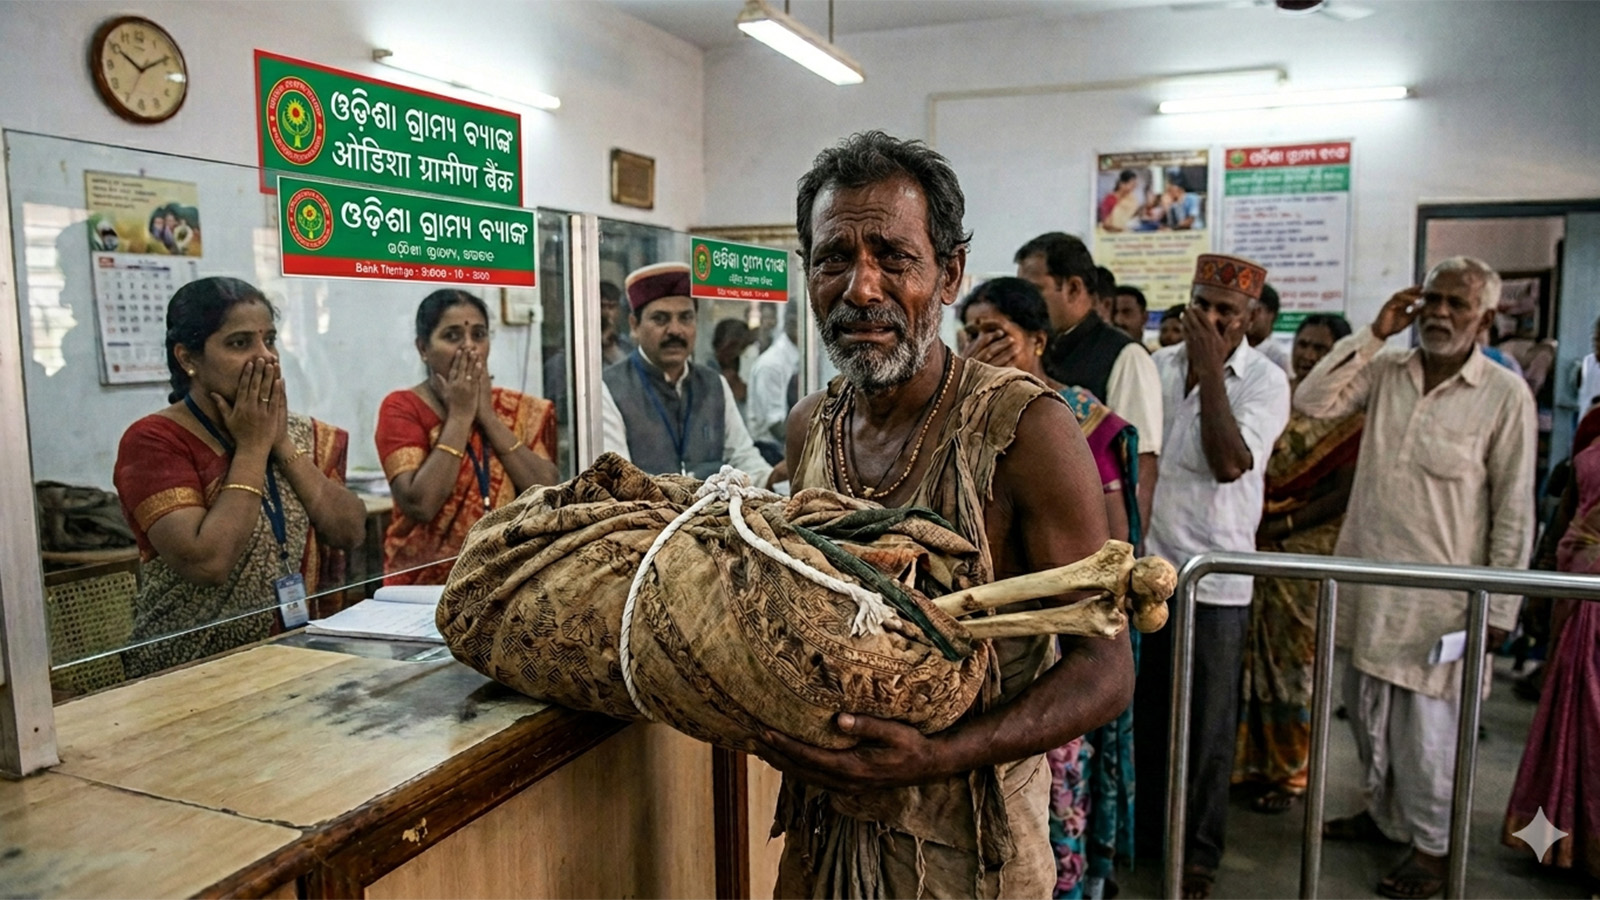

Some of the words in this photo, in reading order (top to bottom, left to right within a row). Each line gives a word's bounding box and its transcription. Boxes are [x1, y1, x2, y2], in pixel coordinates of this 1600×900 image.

[330, 87, 397, 132] ଓଡ଼ିଶା
[405, 108, 457, 143] ଗ୍ରାମ୍ୟ
[331, 132, 412, 178] ओडिशा
[417, 152, 479, 188] ग्रामीण
[483, 158, 515, 193] बैंक
[340, 196, 411, 237] ଓଡ଼ିଶା
[419, 211, 472, 242] ଗ୍ରାମ୍ୟ
[355, 262, 379, 274] Bank
